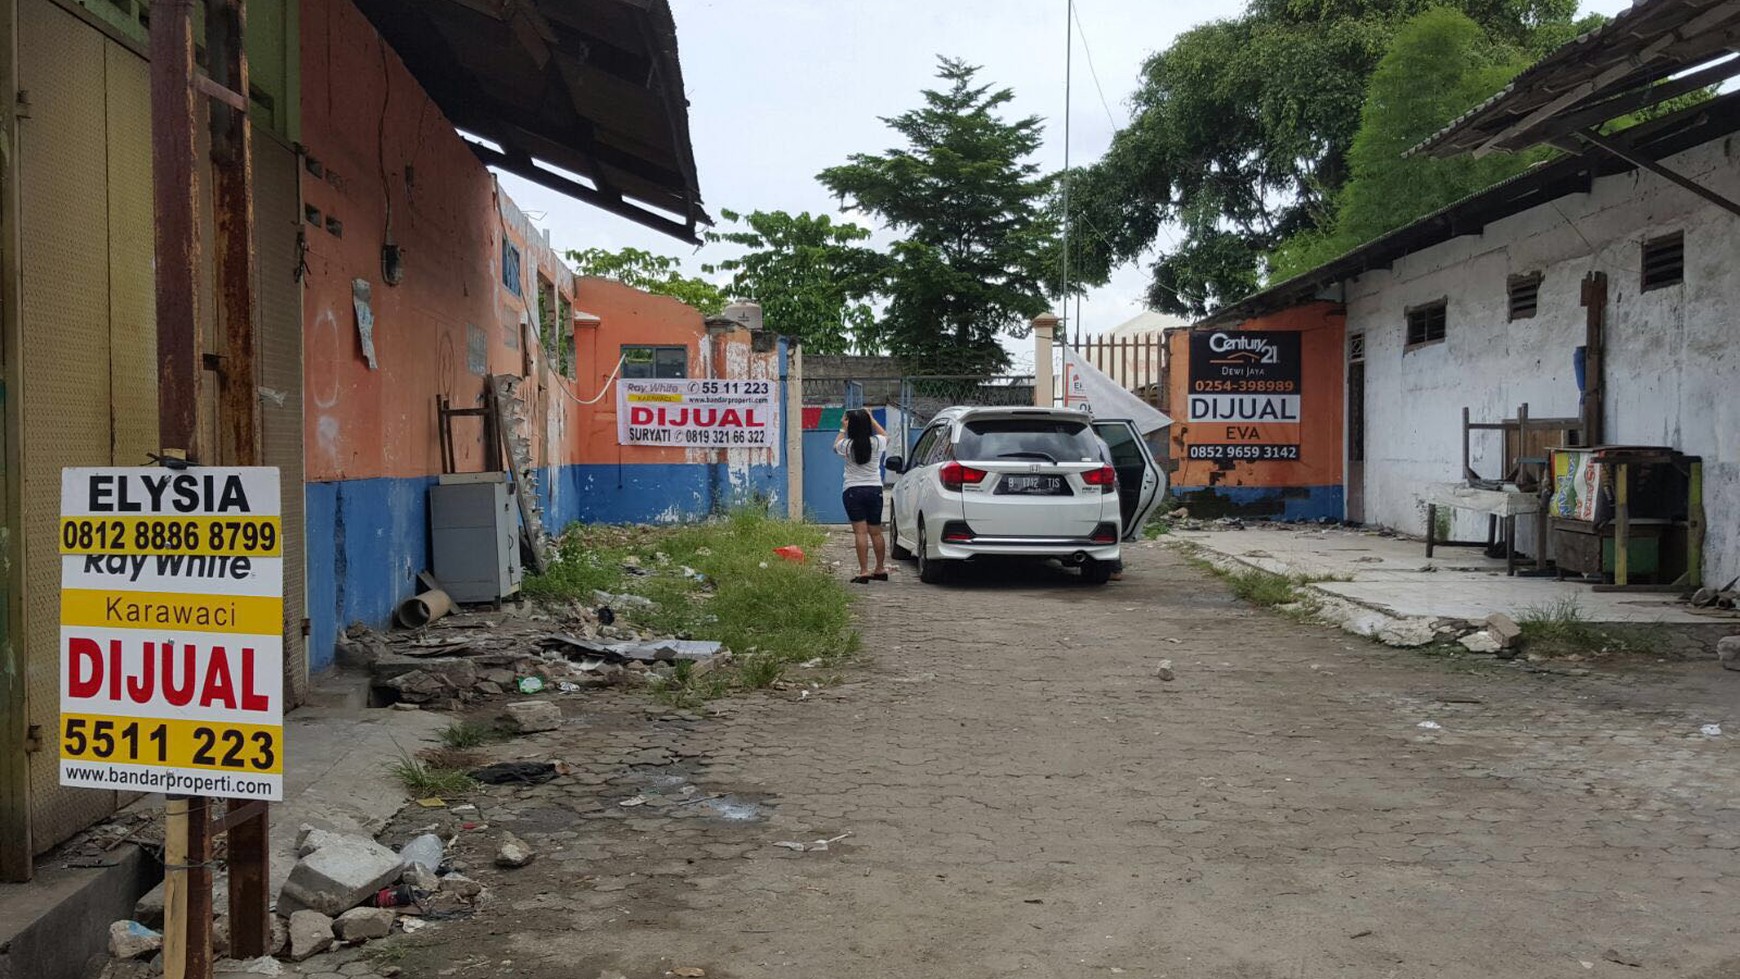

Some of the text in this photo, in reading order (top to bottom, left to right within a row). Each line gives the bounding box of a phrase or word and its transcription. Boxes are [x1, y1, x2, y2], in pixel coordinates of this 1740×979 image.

[1209, 332, 1278, 364] Century 21
[627, 383, 679, 394] Ray White
[702, 382, 769, 394] 55 11 223
[1195, 380, 1294, 392] 0254-398989
[630, 406, 765, 428] DIJUAL
[1191, 397, 1297, 420] DIJUAL
[629, 428, 765, 443] SURYATI 0819 321 66 322
[1226, 426, 1261, 440] EVA
[1190, 446, 1297, 458] 0852 9659 3142
[88, 474, 251, 513] ELYSIA
[62, 520, 276, 552] 0812 8886 8799
[84, 554, 251, 582] Ray White
[106, 596, 236, 627] Karawaci
[68, 637, 270, 712] DIJUAL
[64, 718, 276, 771] 5511 223
[65, 765, 273, 796] www.bandarproperti.com
